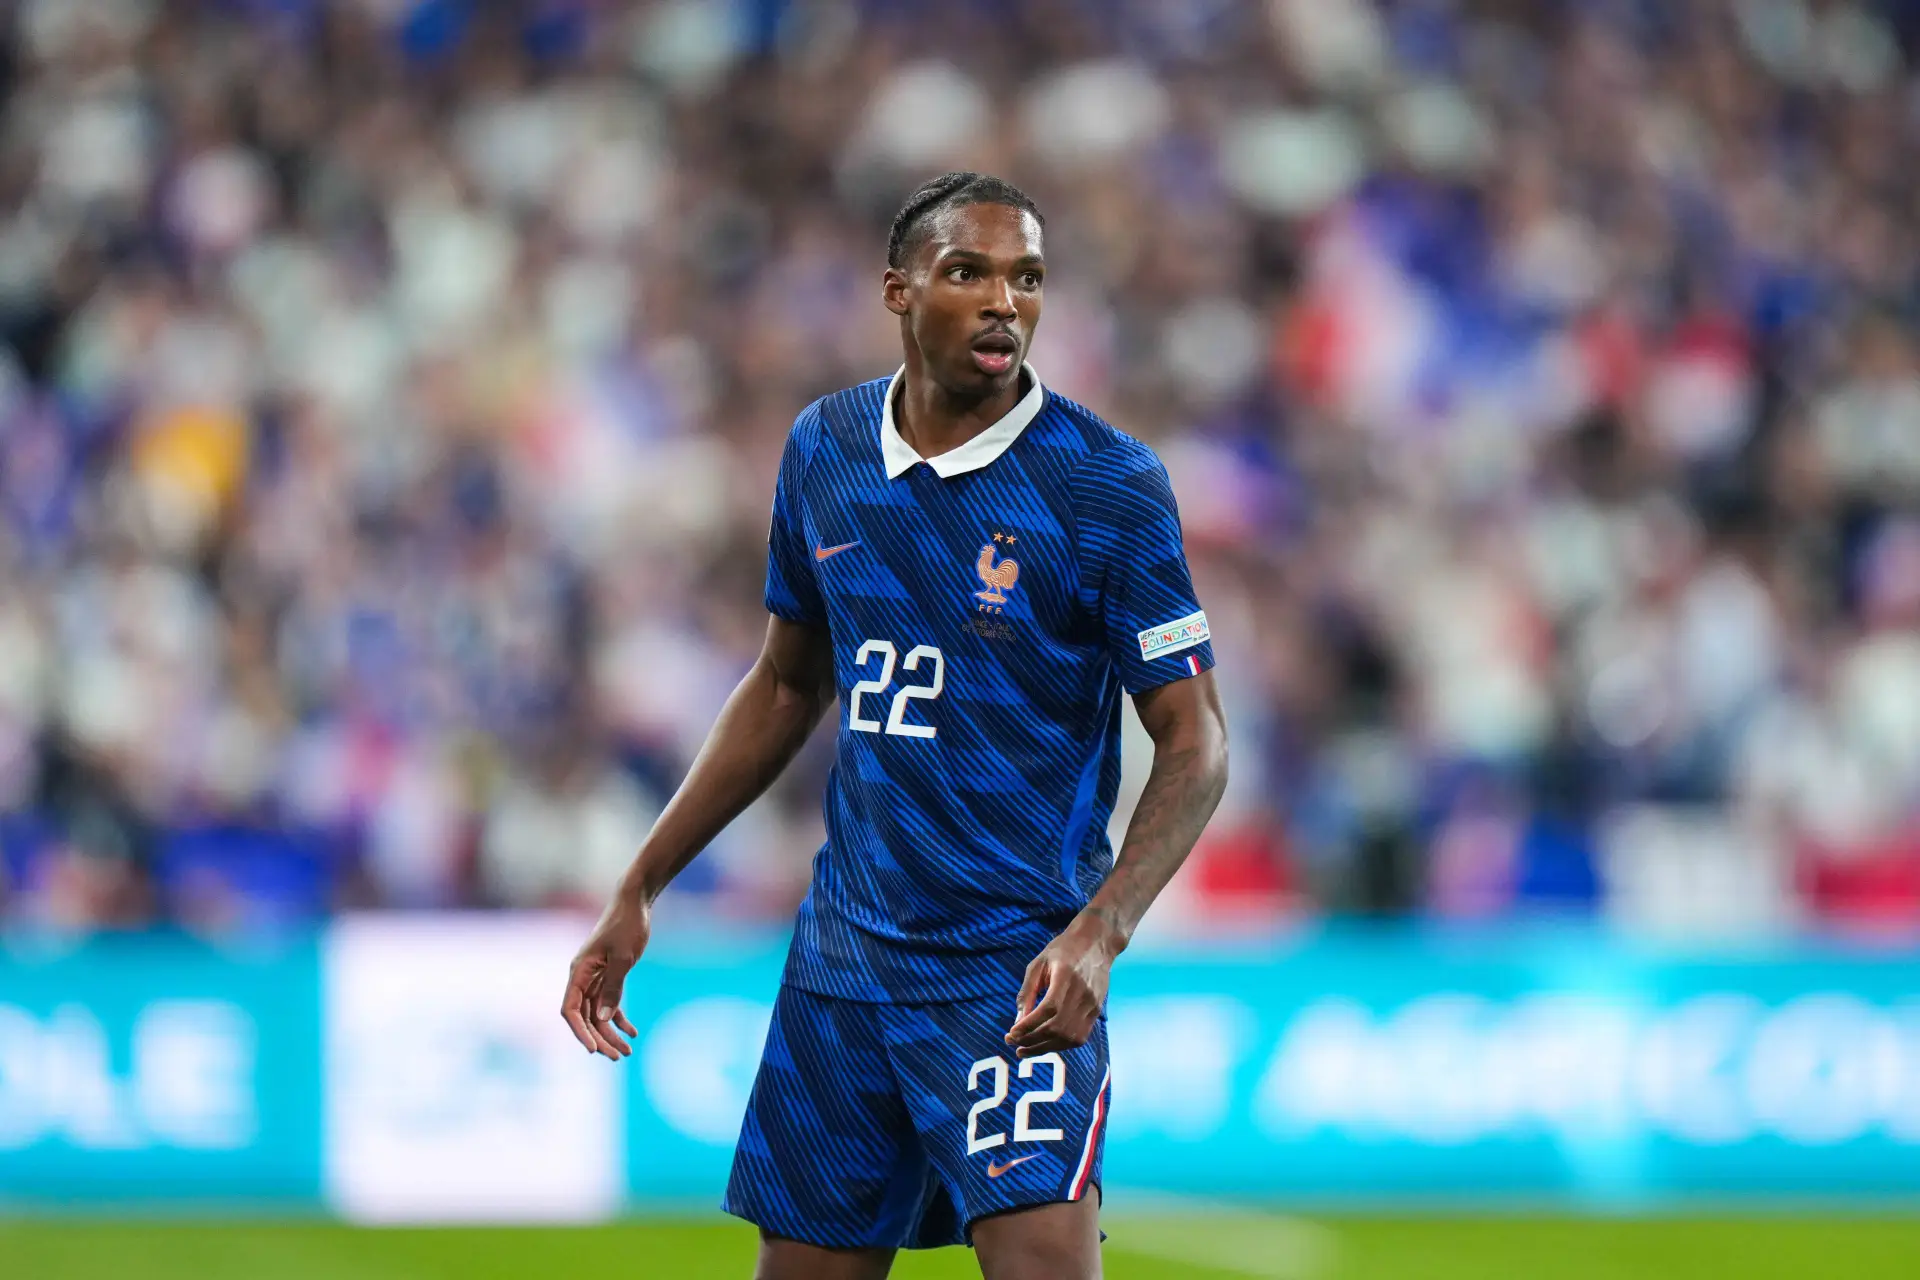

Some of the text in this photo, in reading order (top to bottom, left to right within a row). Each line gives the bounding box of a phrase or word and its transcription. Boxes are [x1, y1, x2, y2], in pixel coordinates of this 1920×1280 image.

[979, 604, 1002, 614] FFF
[1140, 630, 1155, 641] UEFA
[1141, 619, 1207, 652] FOUNDATION
[849, 639, 945, 739] 22
[967, 1052, 1066, 1156] 22
